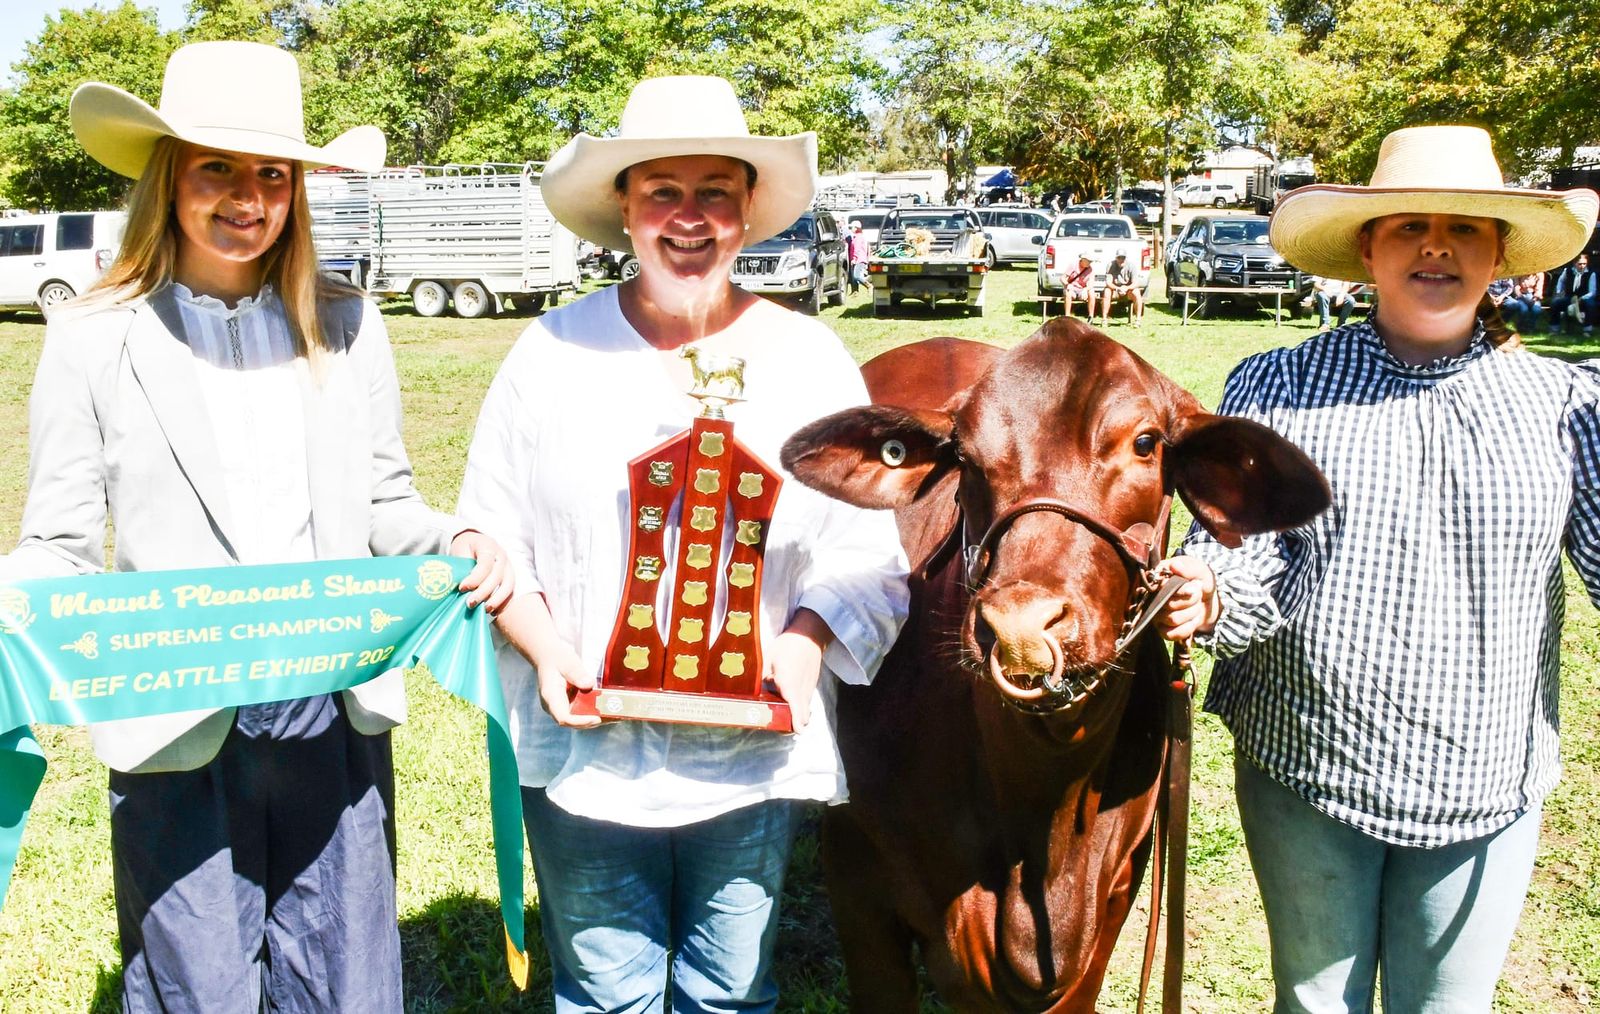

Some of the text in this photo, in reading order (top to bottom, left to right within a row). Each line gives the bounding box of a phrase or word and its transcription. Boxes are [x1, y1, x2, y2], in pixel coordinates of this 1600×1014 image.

[50, 589, 164, 619] Mount
[171, 584, 314, 605] Pleasant
[324, 575, 405, 598] Show
[110, 615, 362, 651] SUPREME CHAMPION
[133, 663, 242, 693] CATTLE
[248, 652, 354, 680] EXHIBIT
